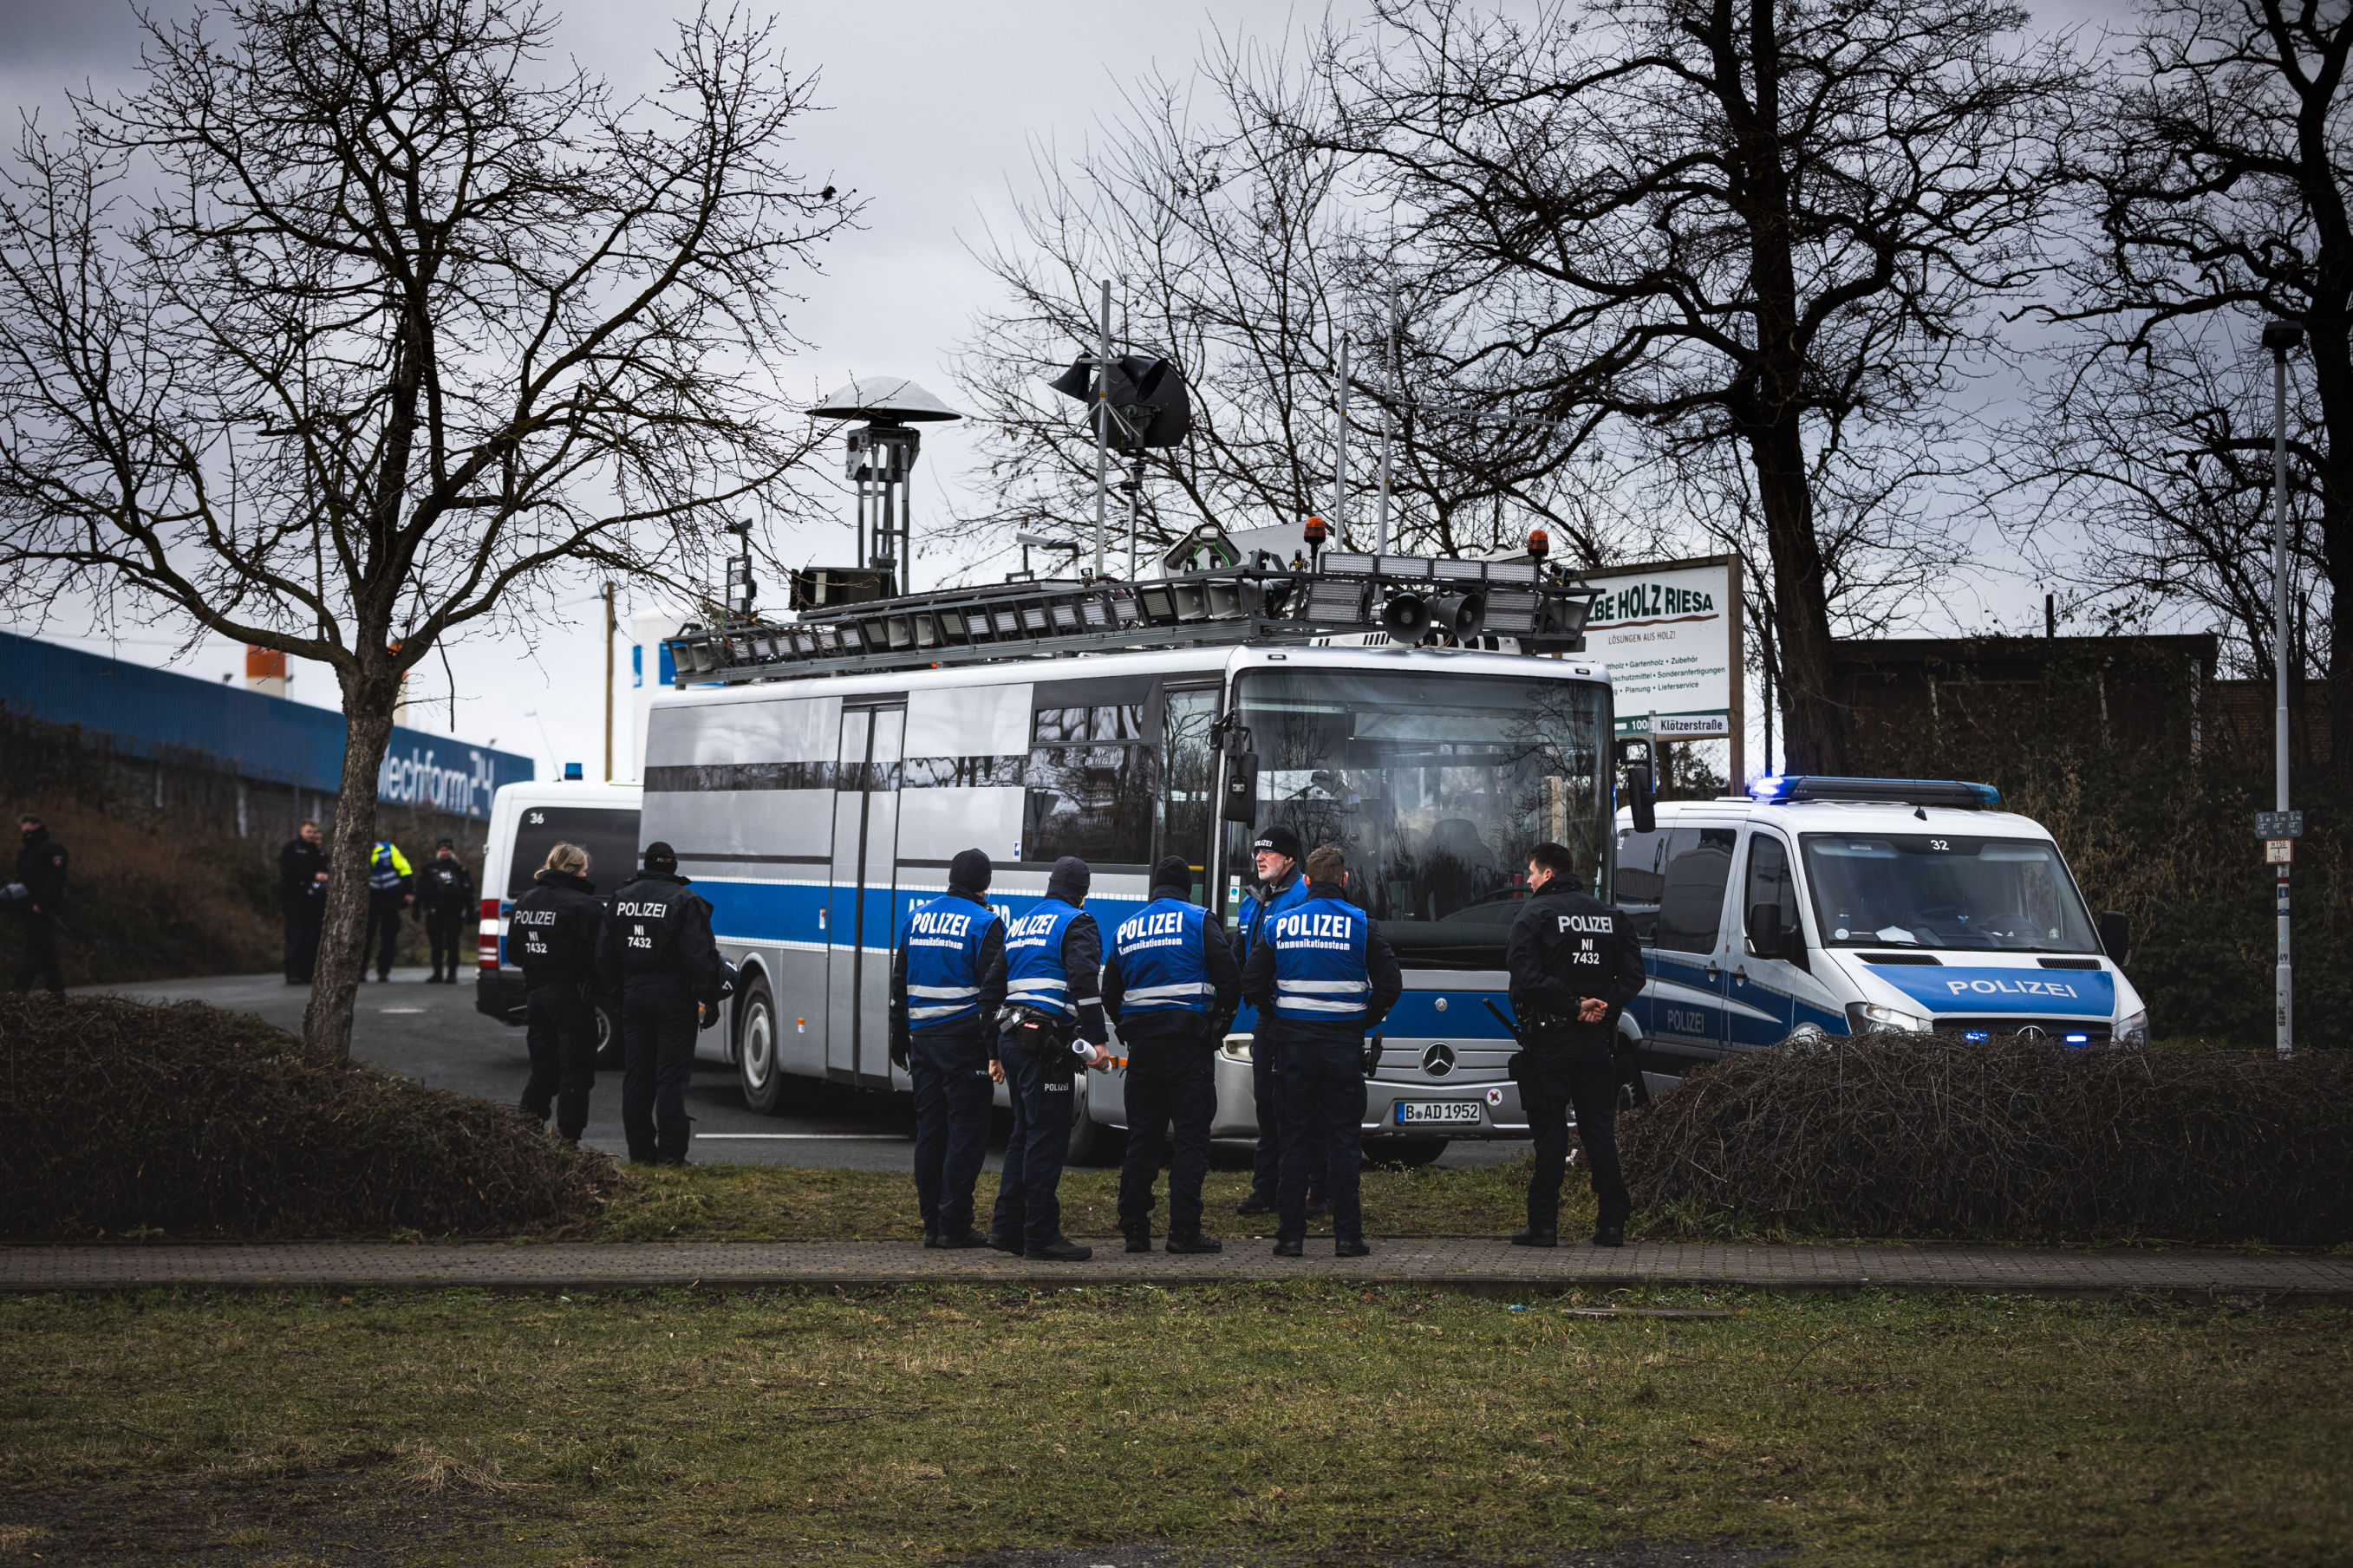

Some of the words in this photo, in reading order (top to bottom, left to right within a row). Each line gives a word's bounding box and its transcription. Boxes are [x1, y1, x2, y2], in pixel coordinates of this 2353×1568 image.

[1618, 583, 1662, 619] HOLZ
[1665, 587, 1714, 615] RIESA
[1608, 634, 1641, 645] LÖSUNGEN
[1643, 633, 1655, 641] AUS
[1657, 630, 1676, 641] HOLZ!
[1607, 661, 1624, 670] ttholz
[1630, 658, 1665, 668] Gartenholz
[1671, 655, 1698, 665] Zubehör
[1657, 666, 1726, 680] Sonderanfertigungen
[1625, 685, 1651, 695] Planung
[1658, 680, 1699, 691] Lieferservice
[1660, 719, 1723, 732] Klötzerstraße
[530, 812, 544, 824] 36
[1930, 839, 1950, 850] 32
[616, 901, 667, 919] POLIZEI
[514, 910, 556, 927] POLIZEI
[910, 912, 972, 937] POLIZEI
[1557, 915, 1613, 934] POLIZEI
[634, 924, 644, 936] NI
[1117, 911, 1183, 944] POLIZEI
[1275, 914, 1352, 939] POLIZEI
[528, 930, 539, 942] NI
[627, 936, 652, 949] 7432
[525, 942, 548, 953] 7432
[1118, 937, 1183, 957] Kommunikationsteam
[1275, 938, 1351, 951] Kommunikationsteam
[1581, 939, 1594, 951] NI
[1572, 952, 1600, 965] 7432
[2278, 953, 2289, 962] 49
[1946, 979, 2079, 999] POLIZEI
[1666, 1008, 1704, 1034] POLIZEI
[1044, 1082, 1069, 1092] POLIZEI
[1405, 1104, 1415, 1120] B
[1424, 1104, 1442, 1119] AD
[1444, 1103, 1479, 1119] 1952
